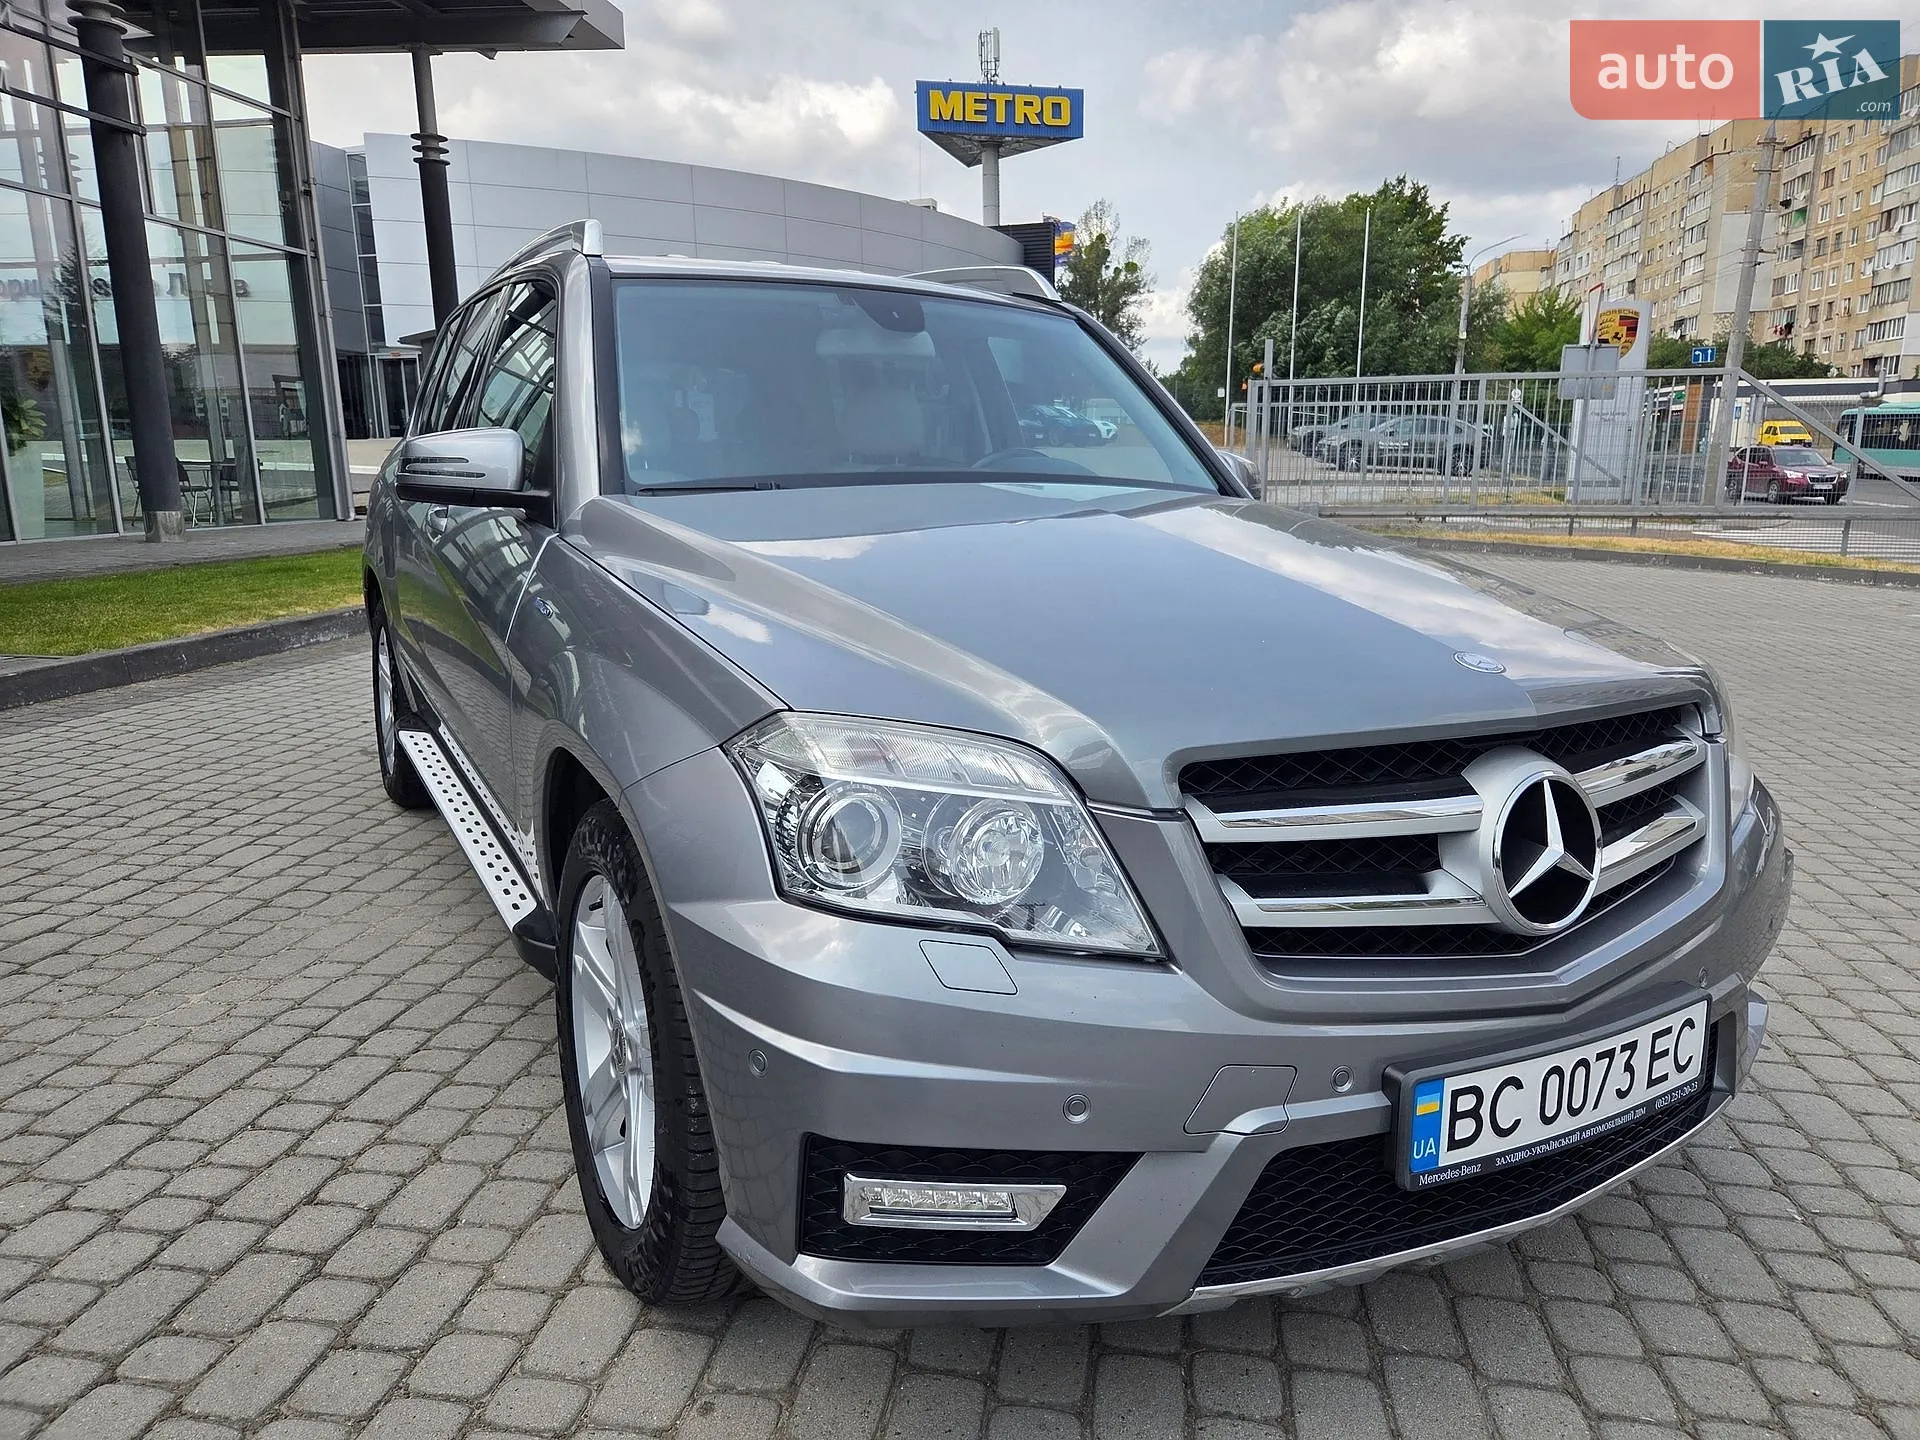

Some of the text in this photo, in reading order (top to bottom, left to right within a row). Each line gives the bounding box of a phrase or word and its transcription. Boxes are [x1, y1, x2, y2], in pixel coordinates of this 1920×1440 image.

[929, 89, 1071, 126] METRO
[1446, 1017, 1696, 1152] BC 0073 EC
[1412, 1136, 1437, 1159] UA
[1419, 1162, 1482, 1186] Mercedes-Benz
